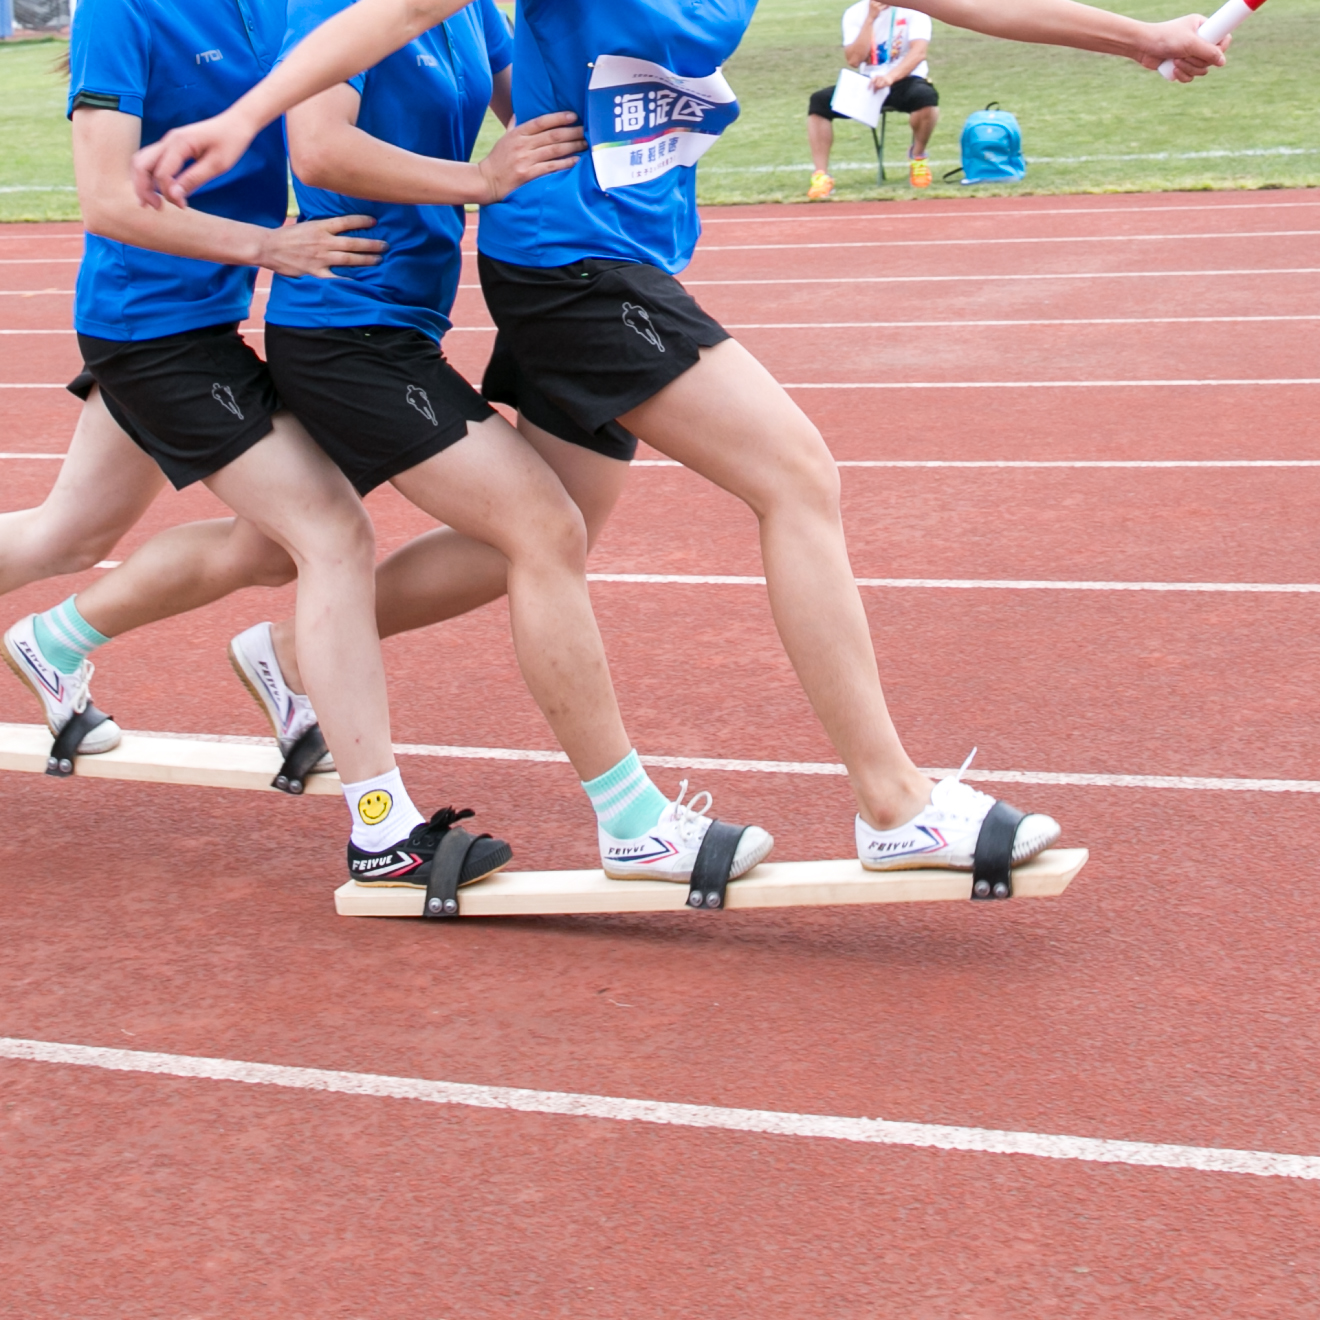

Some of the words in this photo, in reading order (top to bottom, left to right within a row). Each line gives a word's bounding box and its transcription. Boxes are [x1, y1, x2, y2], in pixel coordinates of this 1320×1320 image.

[613, 89, 717, 133] 海淀区
[351, 854, 394, 871] FEIYUE
